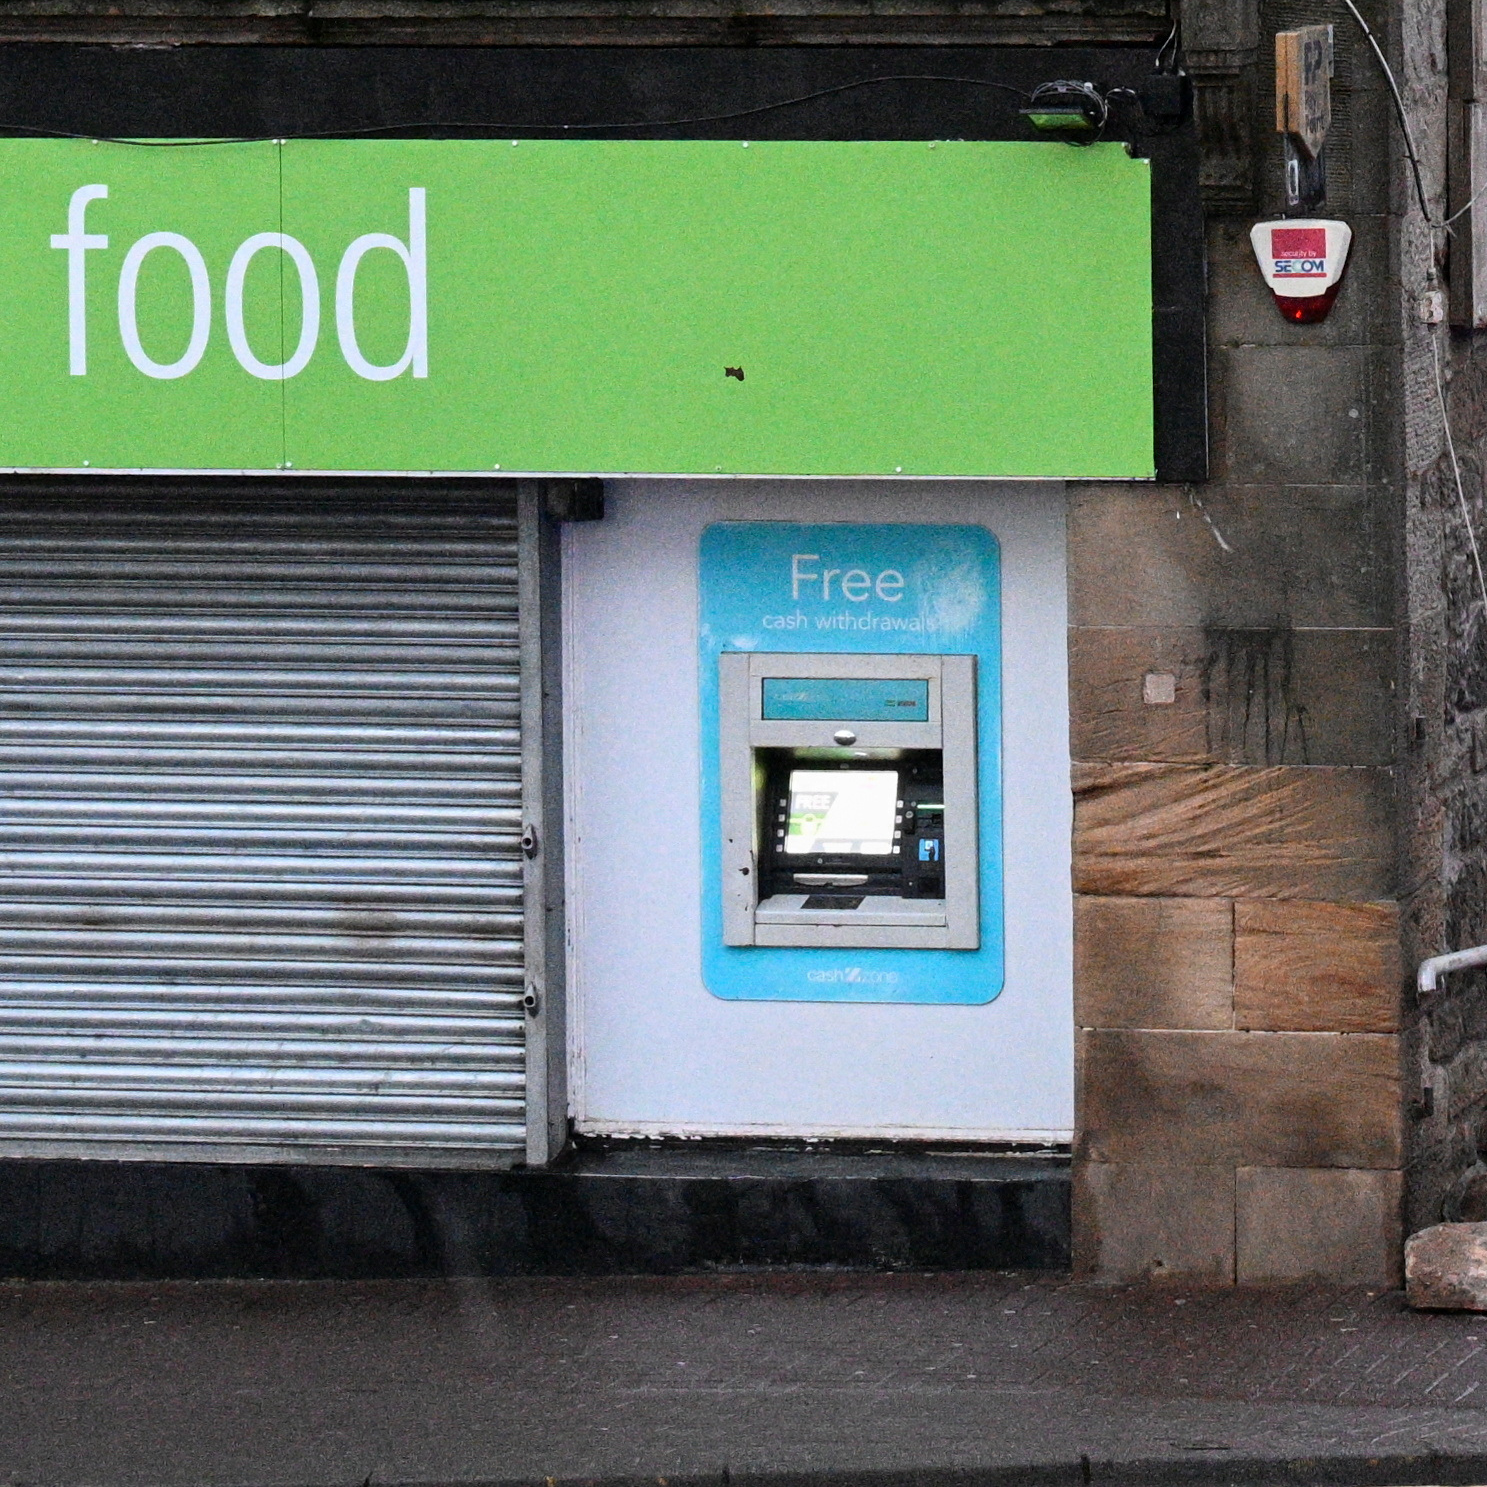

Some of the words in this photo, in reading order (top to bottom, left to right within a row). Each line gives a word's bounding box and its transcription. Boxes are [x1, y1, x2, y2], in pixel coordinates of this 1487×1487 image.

[1274, 260, 1325, 273] SECOM
[50, 183, 428, 381] food
[792, 554, 905, 602] Free
[762, 609, 808, 630] cash
[814, 610, 936, 632] withdrawals
[795, 793, 832, 810] FREE
